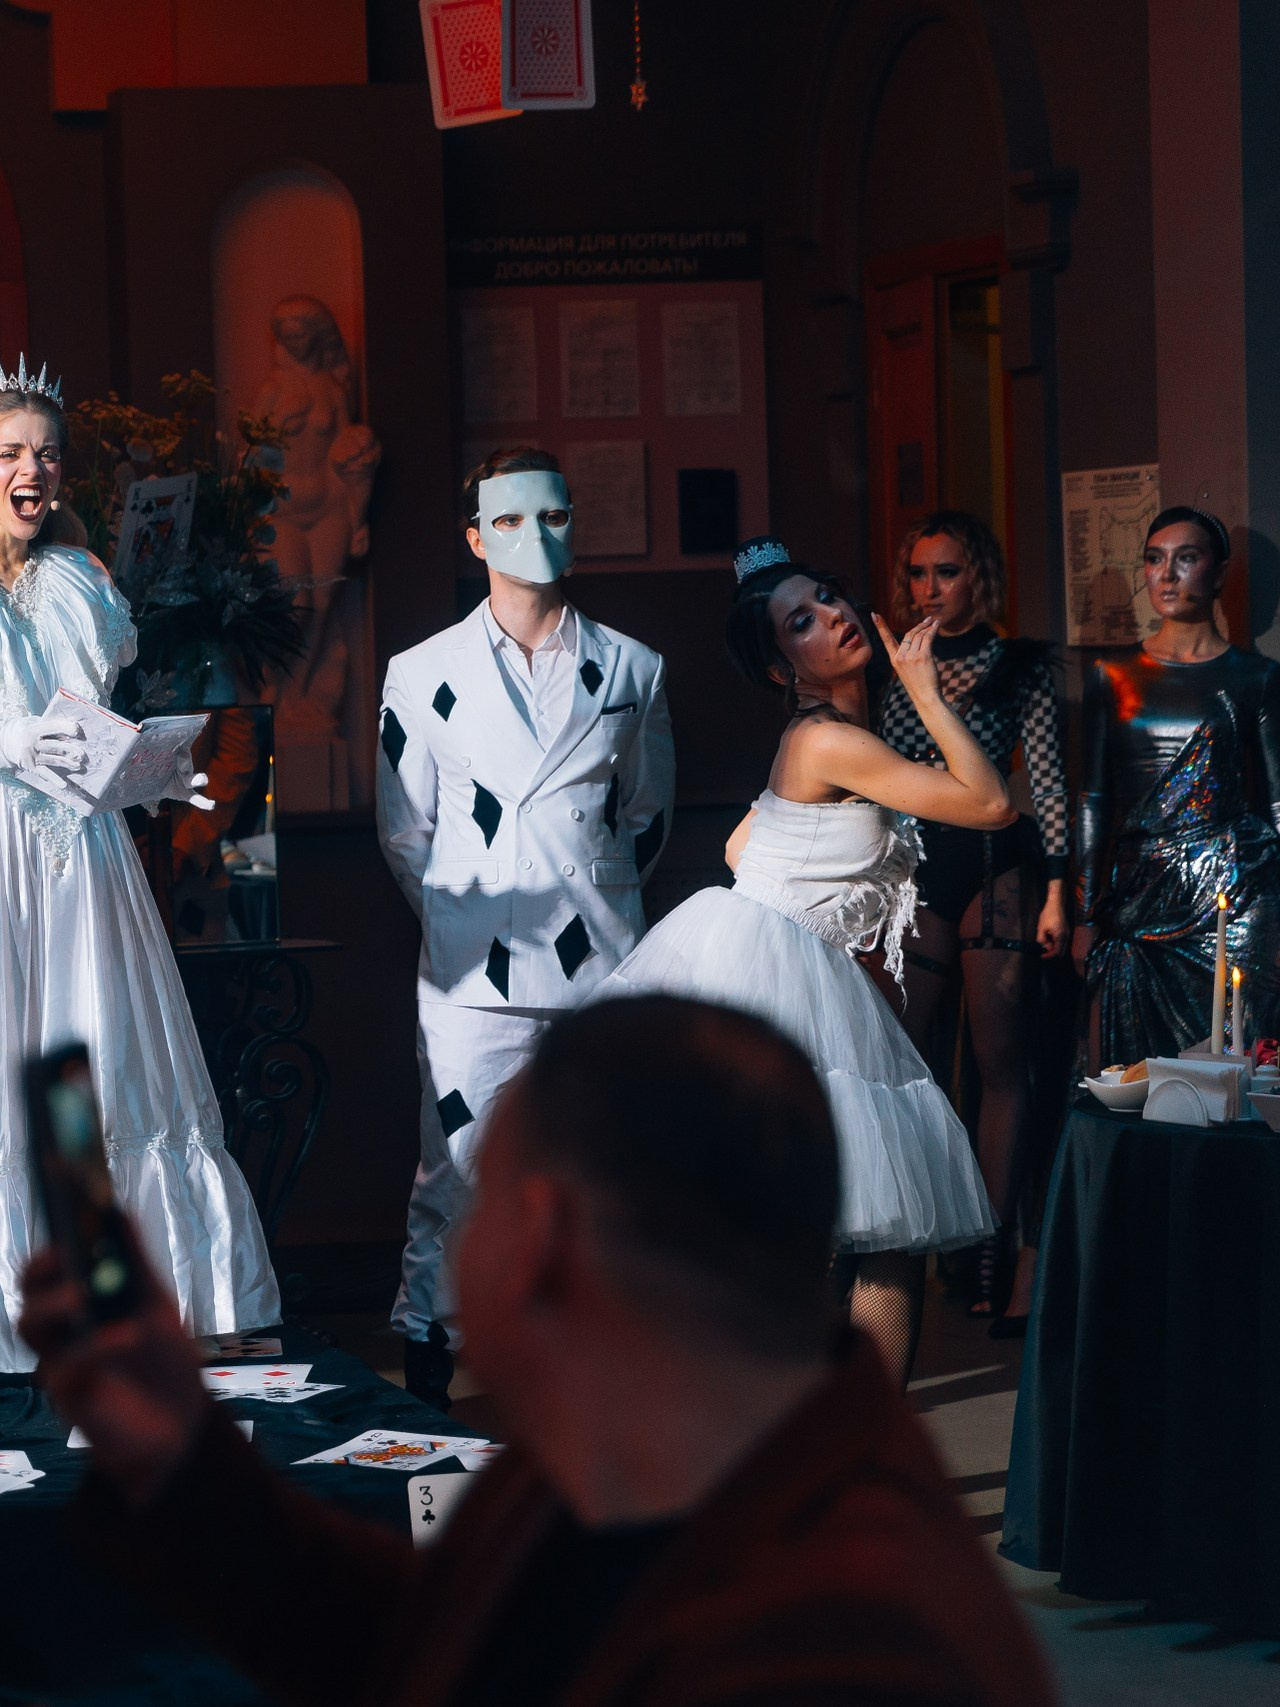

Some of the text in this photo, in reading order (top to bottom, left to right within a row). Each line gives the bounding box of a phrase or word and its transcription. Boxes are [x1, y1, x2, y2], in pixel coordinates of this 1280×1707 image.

[577, 233, 617, 254] ДЛЯ
[620, 230, 747, 251] ПОТРЕБИТЕЛЯ
[494, 259, 560, 281] ДОБРО
[420, 1486, 434, 1505] 3
